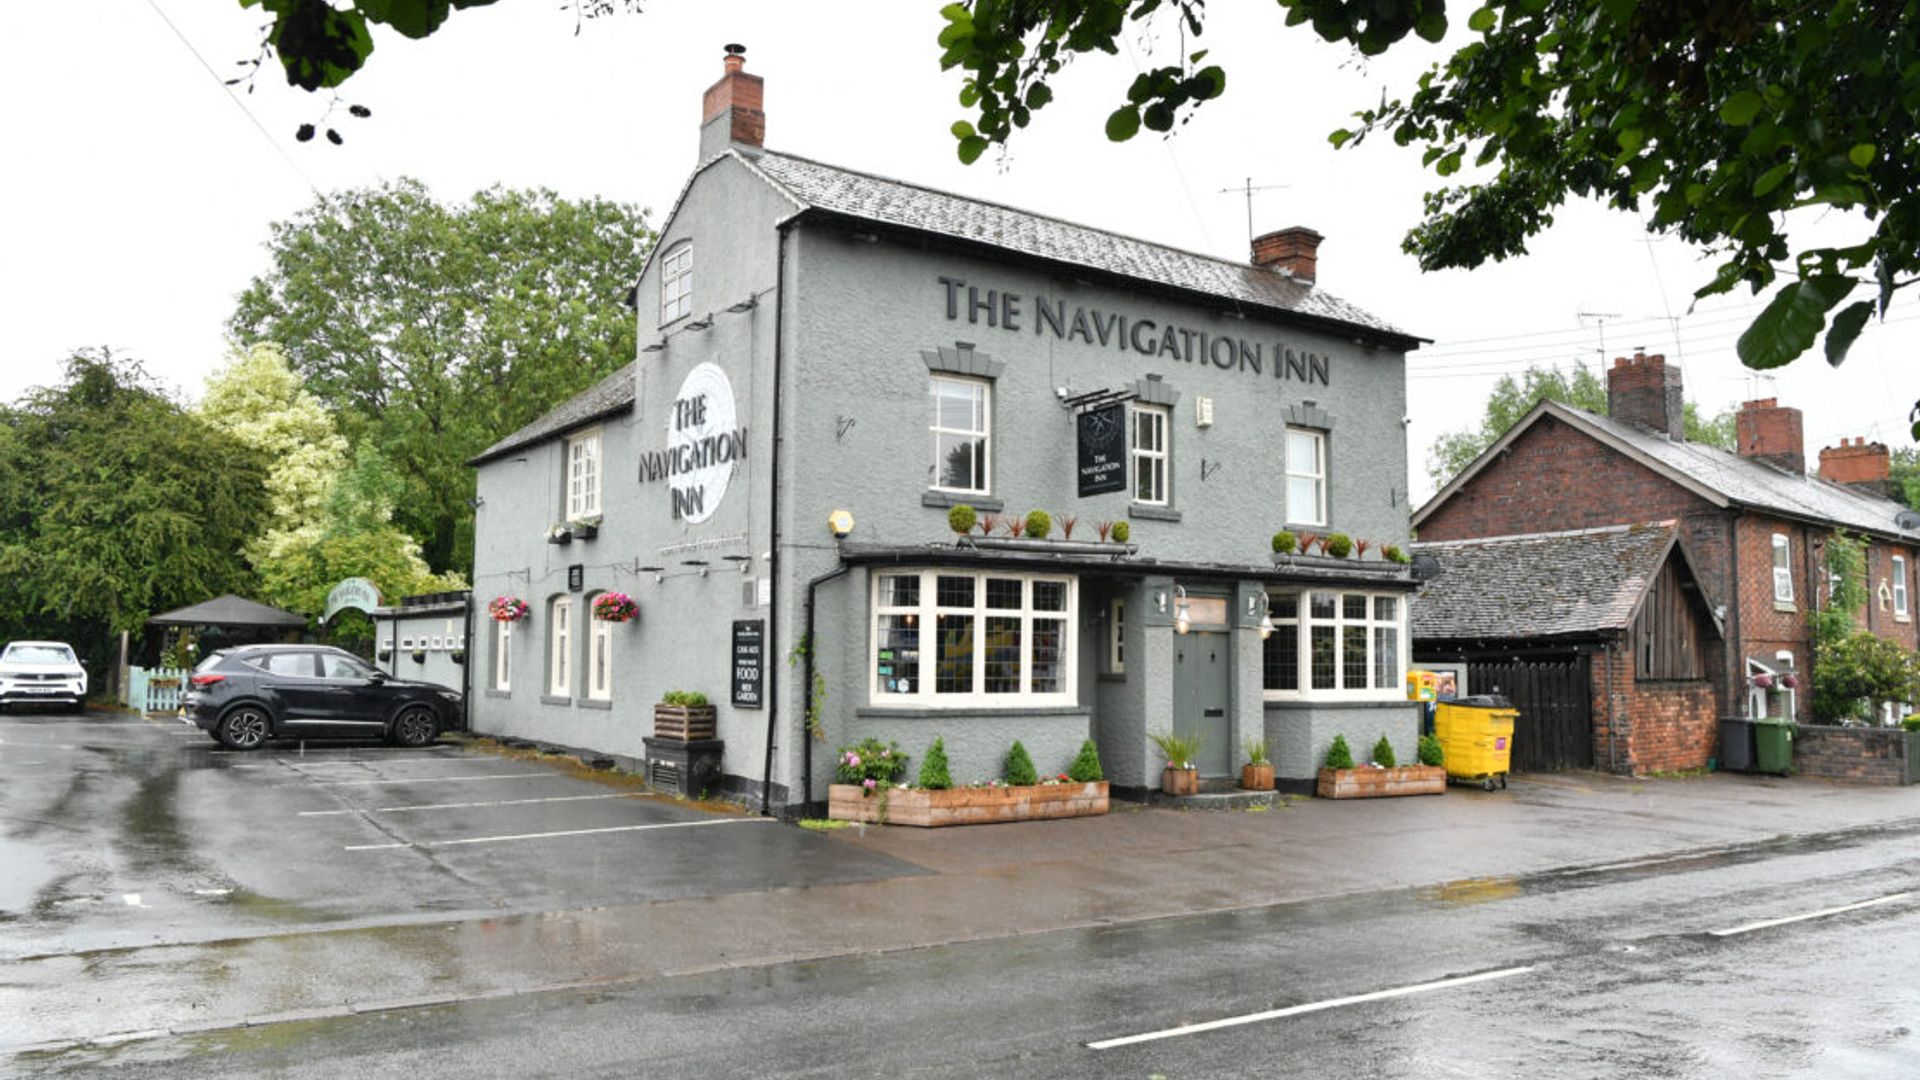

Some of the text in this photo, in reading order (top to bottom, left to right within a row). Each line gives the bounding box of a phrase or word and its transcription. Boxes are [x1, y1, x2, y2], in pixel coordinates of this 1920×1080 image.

[938, 276, 1329, 386] THE NAVIGATION INN
[673, 394, 708, 432] THE
[638, 426, 748, 483] NAVIGATION
[671, 484, 704, 520] INN
